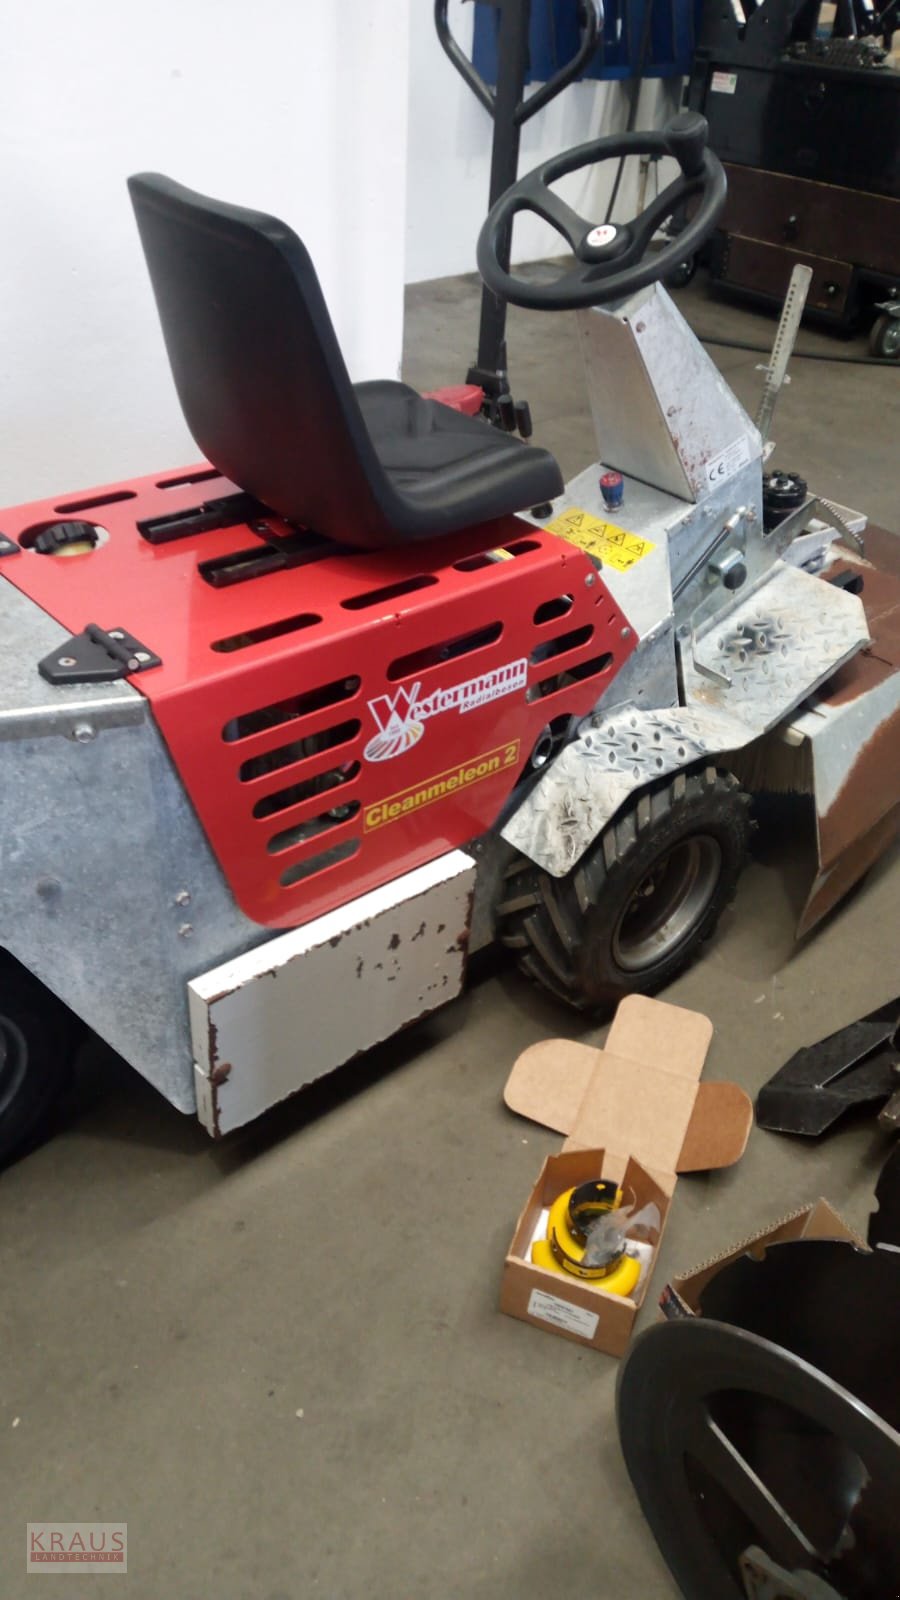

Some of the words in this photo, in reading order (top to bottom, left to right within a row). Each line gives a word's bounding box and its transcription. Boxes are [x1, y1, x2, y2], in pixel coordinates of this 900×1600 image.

[709, 461, 725, 481] CE
[367, 661, 526, 736] Westermann
[463, 679, 525, 710] Radialbesen
[365, 756, 500, 827] Cleanmeleon
[503, 745, 517, 764] 2
